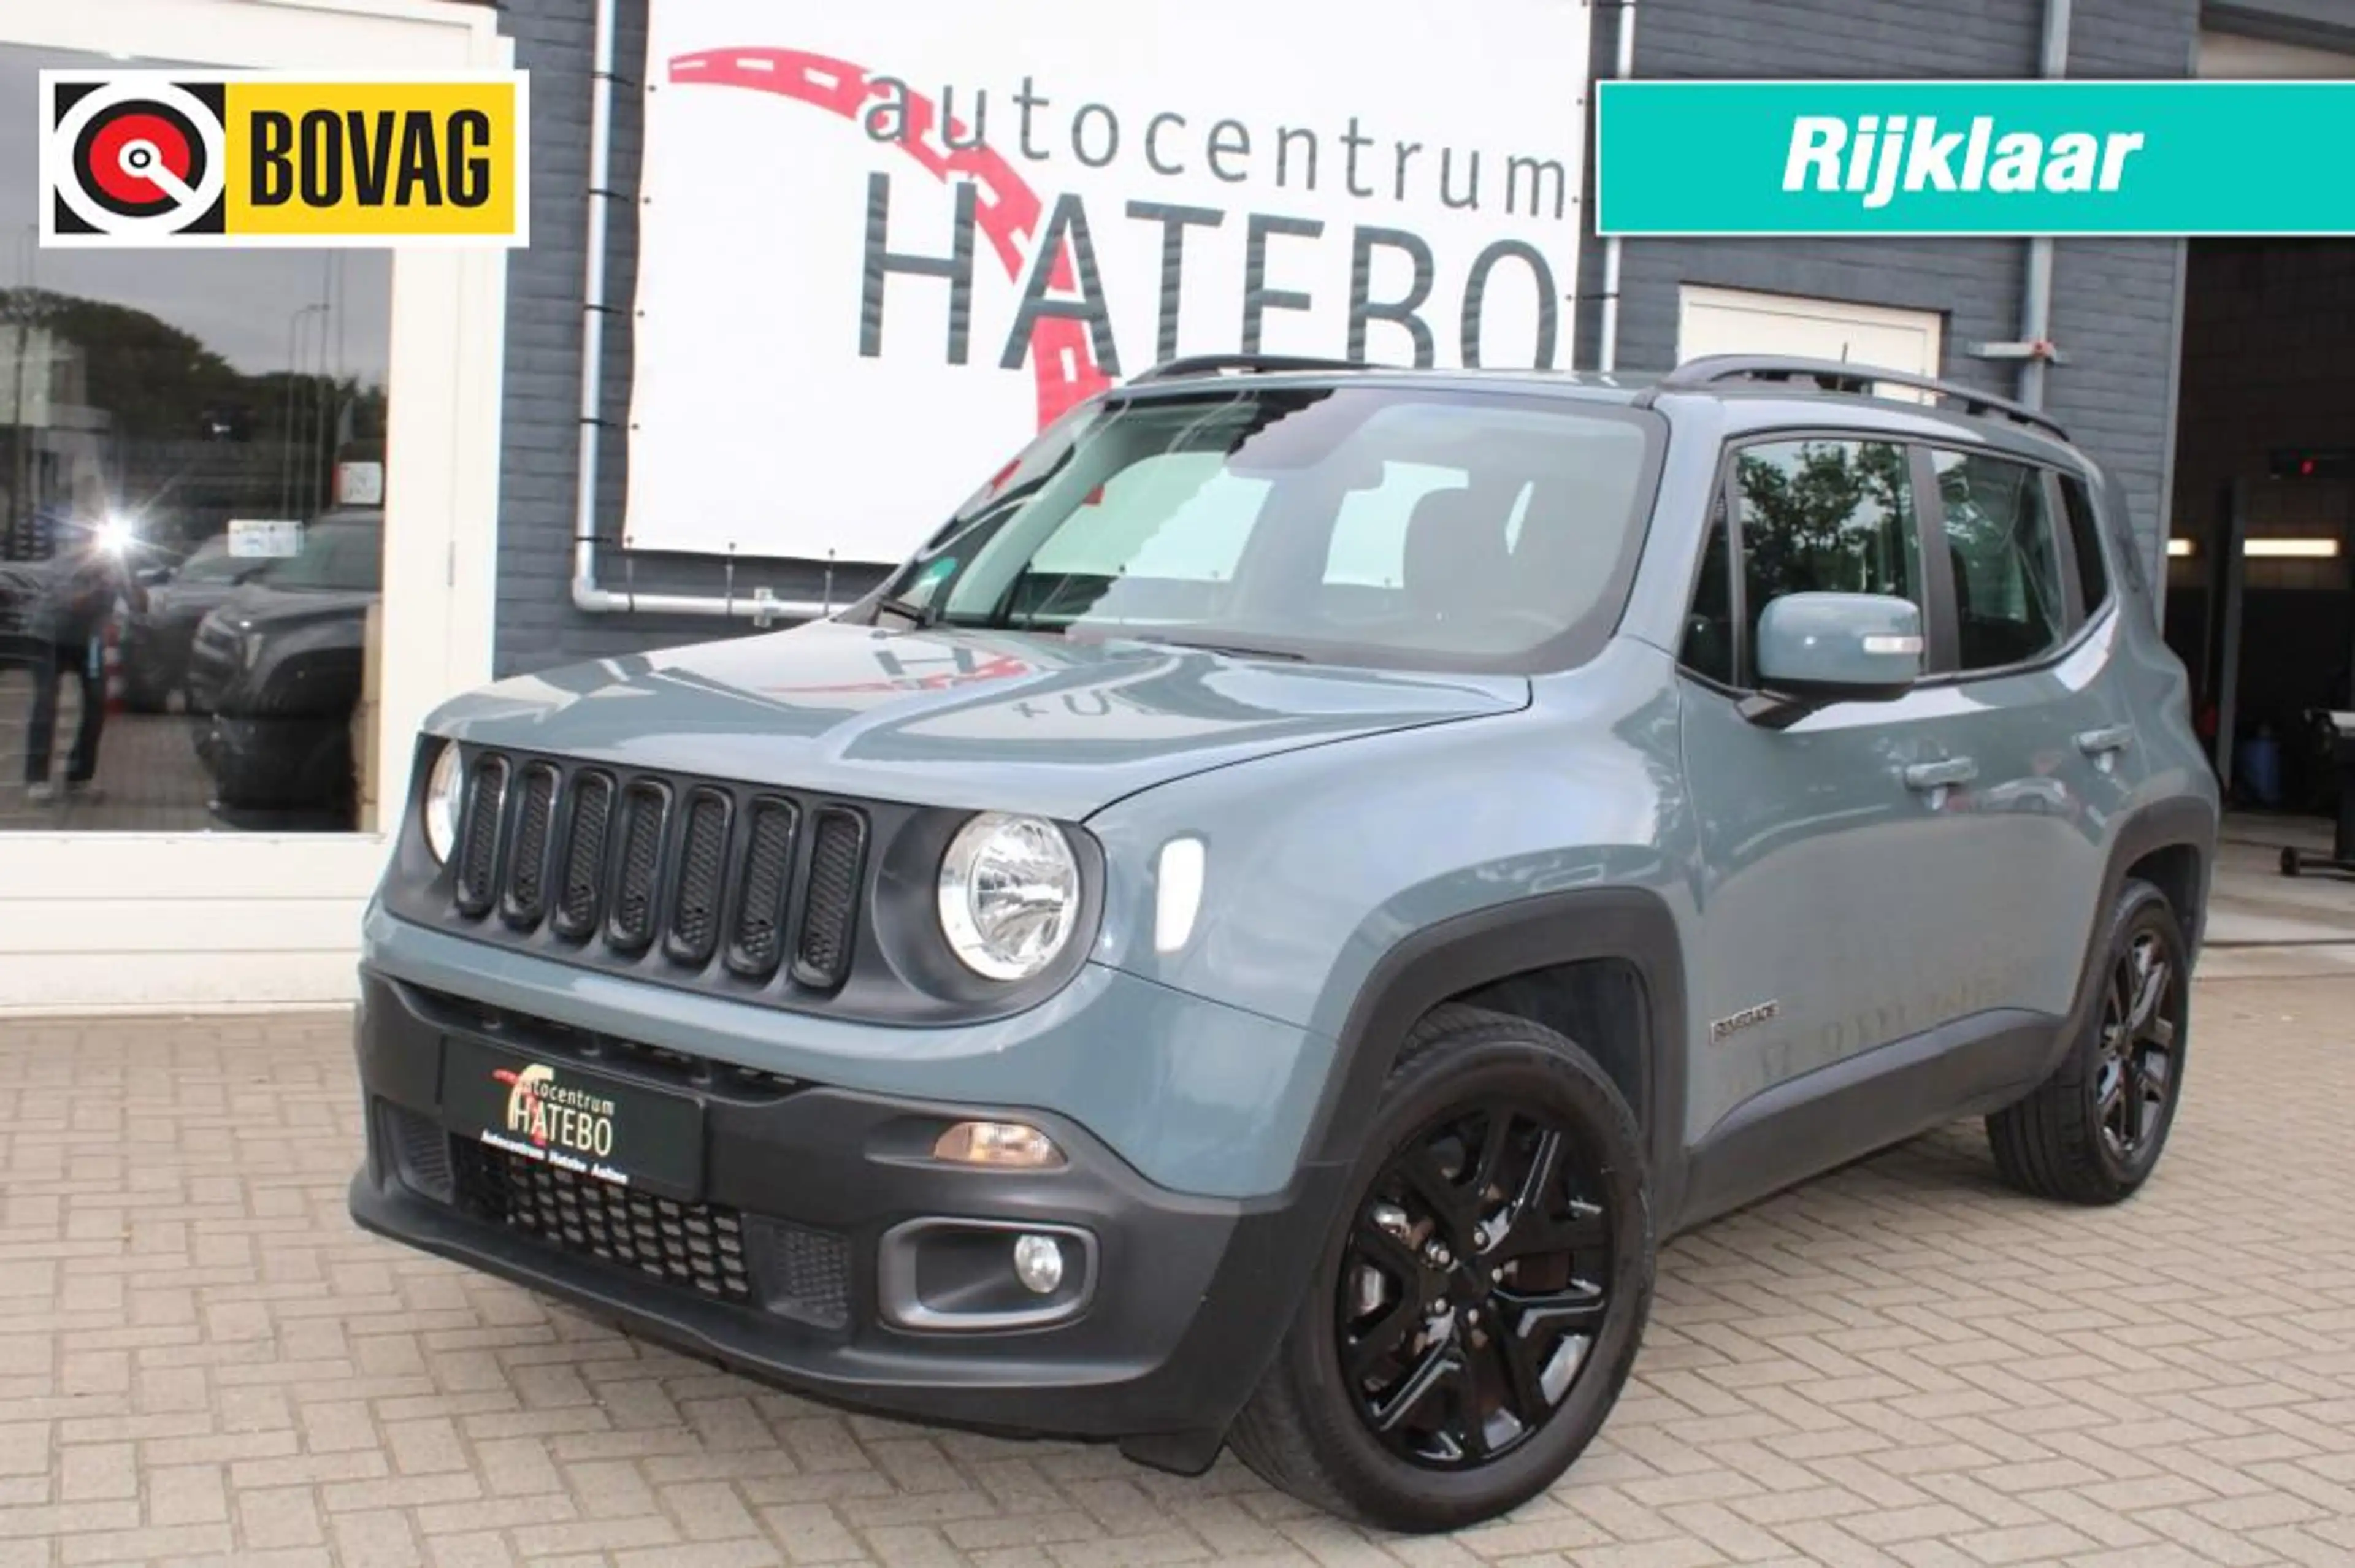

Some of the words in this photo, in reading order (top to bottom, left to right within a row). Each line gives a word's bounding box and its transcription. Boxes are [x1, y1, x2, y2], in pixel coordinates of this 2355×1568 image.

[864, 75, 1568, 220] autocentrum
[858, 170, 1559, 377] HATEBO
[513, 1093, 613, 1158] HATEBO
